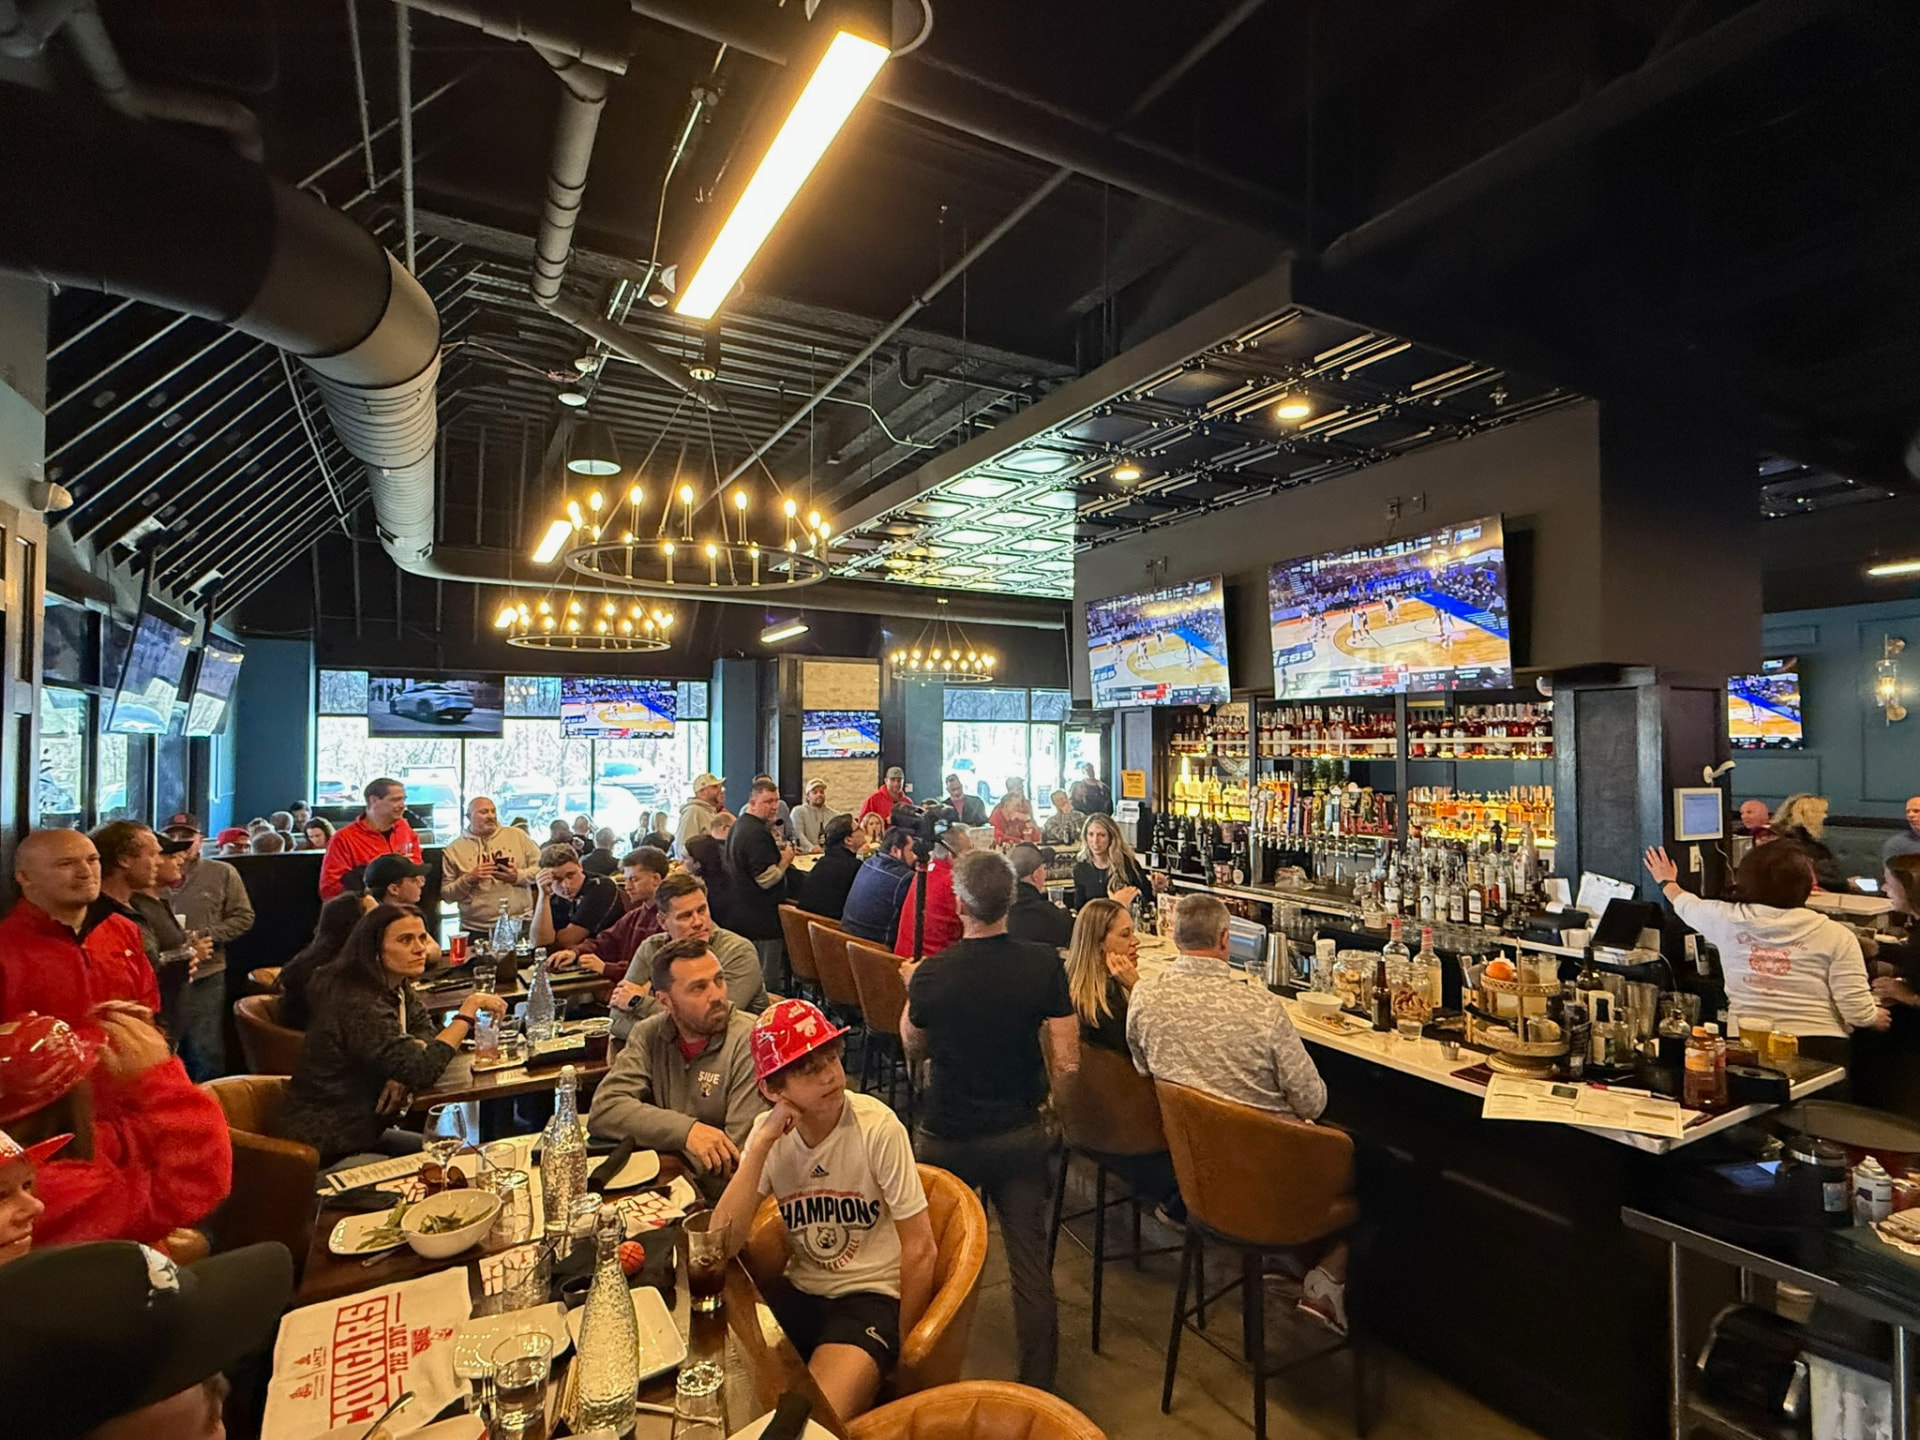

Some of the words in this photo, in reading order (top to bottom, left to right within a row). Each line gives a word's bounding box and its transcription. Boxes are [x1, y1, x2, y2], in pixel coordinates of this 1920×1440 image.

[698, 1071, 720, 1085] SIUE
[780, 1196, 880, 1230] HAMPIONS
[816, 1238, 860, 1272] ASKETBALL
[332, 1297, 388, 1428] COUGARS
[389, 1351, 408, 1375] THE
